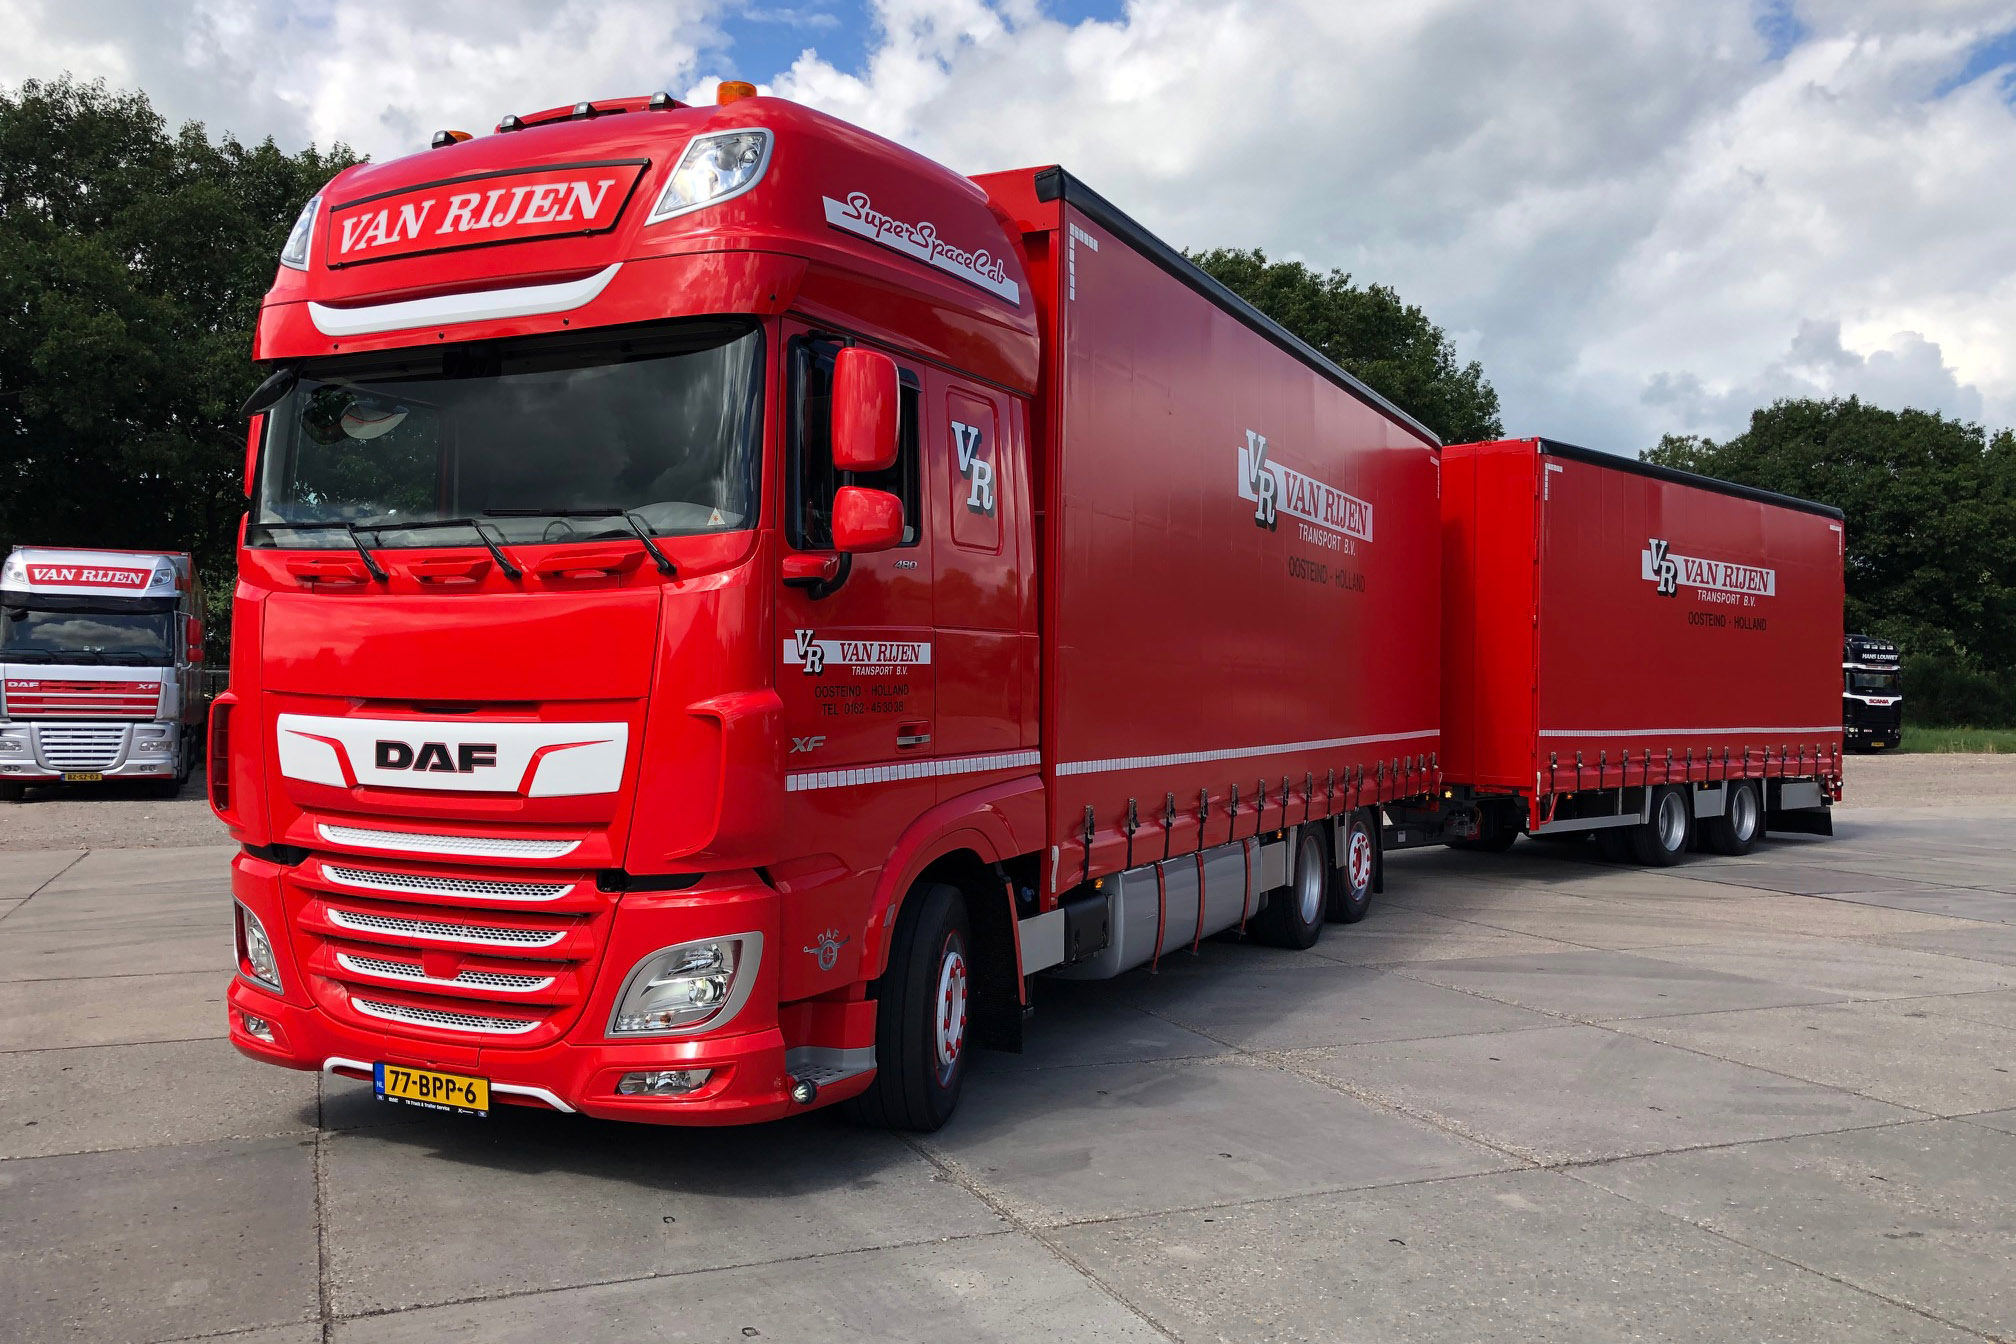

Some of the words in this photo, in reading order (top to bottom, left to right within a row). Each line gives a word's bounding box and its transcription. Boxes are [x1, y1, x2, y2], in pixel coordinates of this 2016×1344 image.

[340, 200, 435, 254] VAN
[434, 179, 615, 235] RIJEN
[842, 195, 1006, 284] SuperSpaceCab
[1284, 470, 1321, 519] VAN
[1323, 488, 1368, 536] RIJEN
[1298, 523, 1341, 551] TRANSPORT
[1344, 539, 1356, 556] B.V.
[894, 560, 917, 570] 480
[1288, 556, 1327, 584] OOSTEIND
[1335, 568, 1366, 593] HOLLAND
[32, 568, 78, 581] VAN
[79, 569, 144, 584] RIJEN
[1683, 559, 1719, 585] VAN
[1722, 565, 1769, 592] RIJEN
[1697, 590, 1740, 605] TRANSPORT
[1743, 596, 1756, 606] B.V.
[1688, 612, 1726, 627] OOSTEIND
[1733, 616, 1767, 631] HOLLAND
[840, 642, 874, 662] VAN
[876, 643, 921, 662] RIJEN
[852, 666, 893, 675] TRANSPORT
[896, 666, 908, 675] B.V.
[815, 685, 861, 698] OOSTEIND
[871, 684, 909, 696] HOLLAND
[822, 703, 838, 716] TEL
[844, 702, 864, 714] 0162
[789, 736, 826, 754] XF
[375, 739, 498, 773] DAF
[817, 928, 839, 944] DAF
[376, 1080, 384, 1089] NL
[388, 1069, 477, 1104] 77-BPP-6
